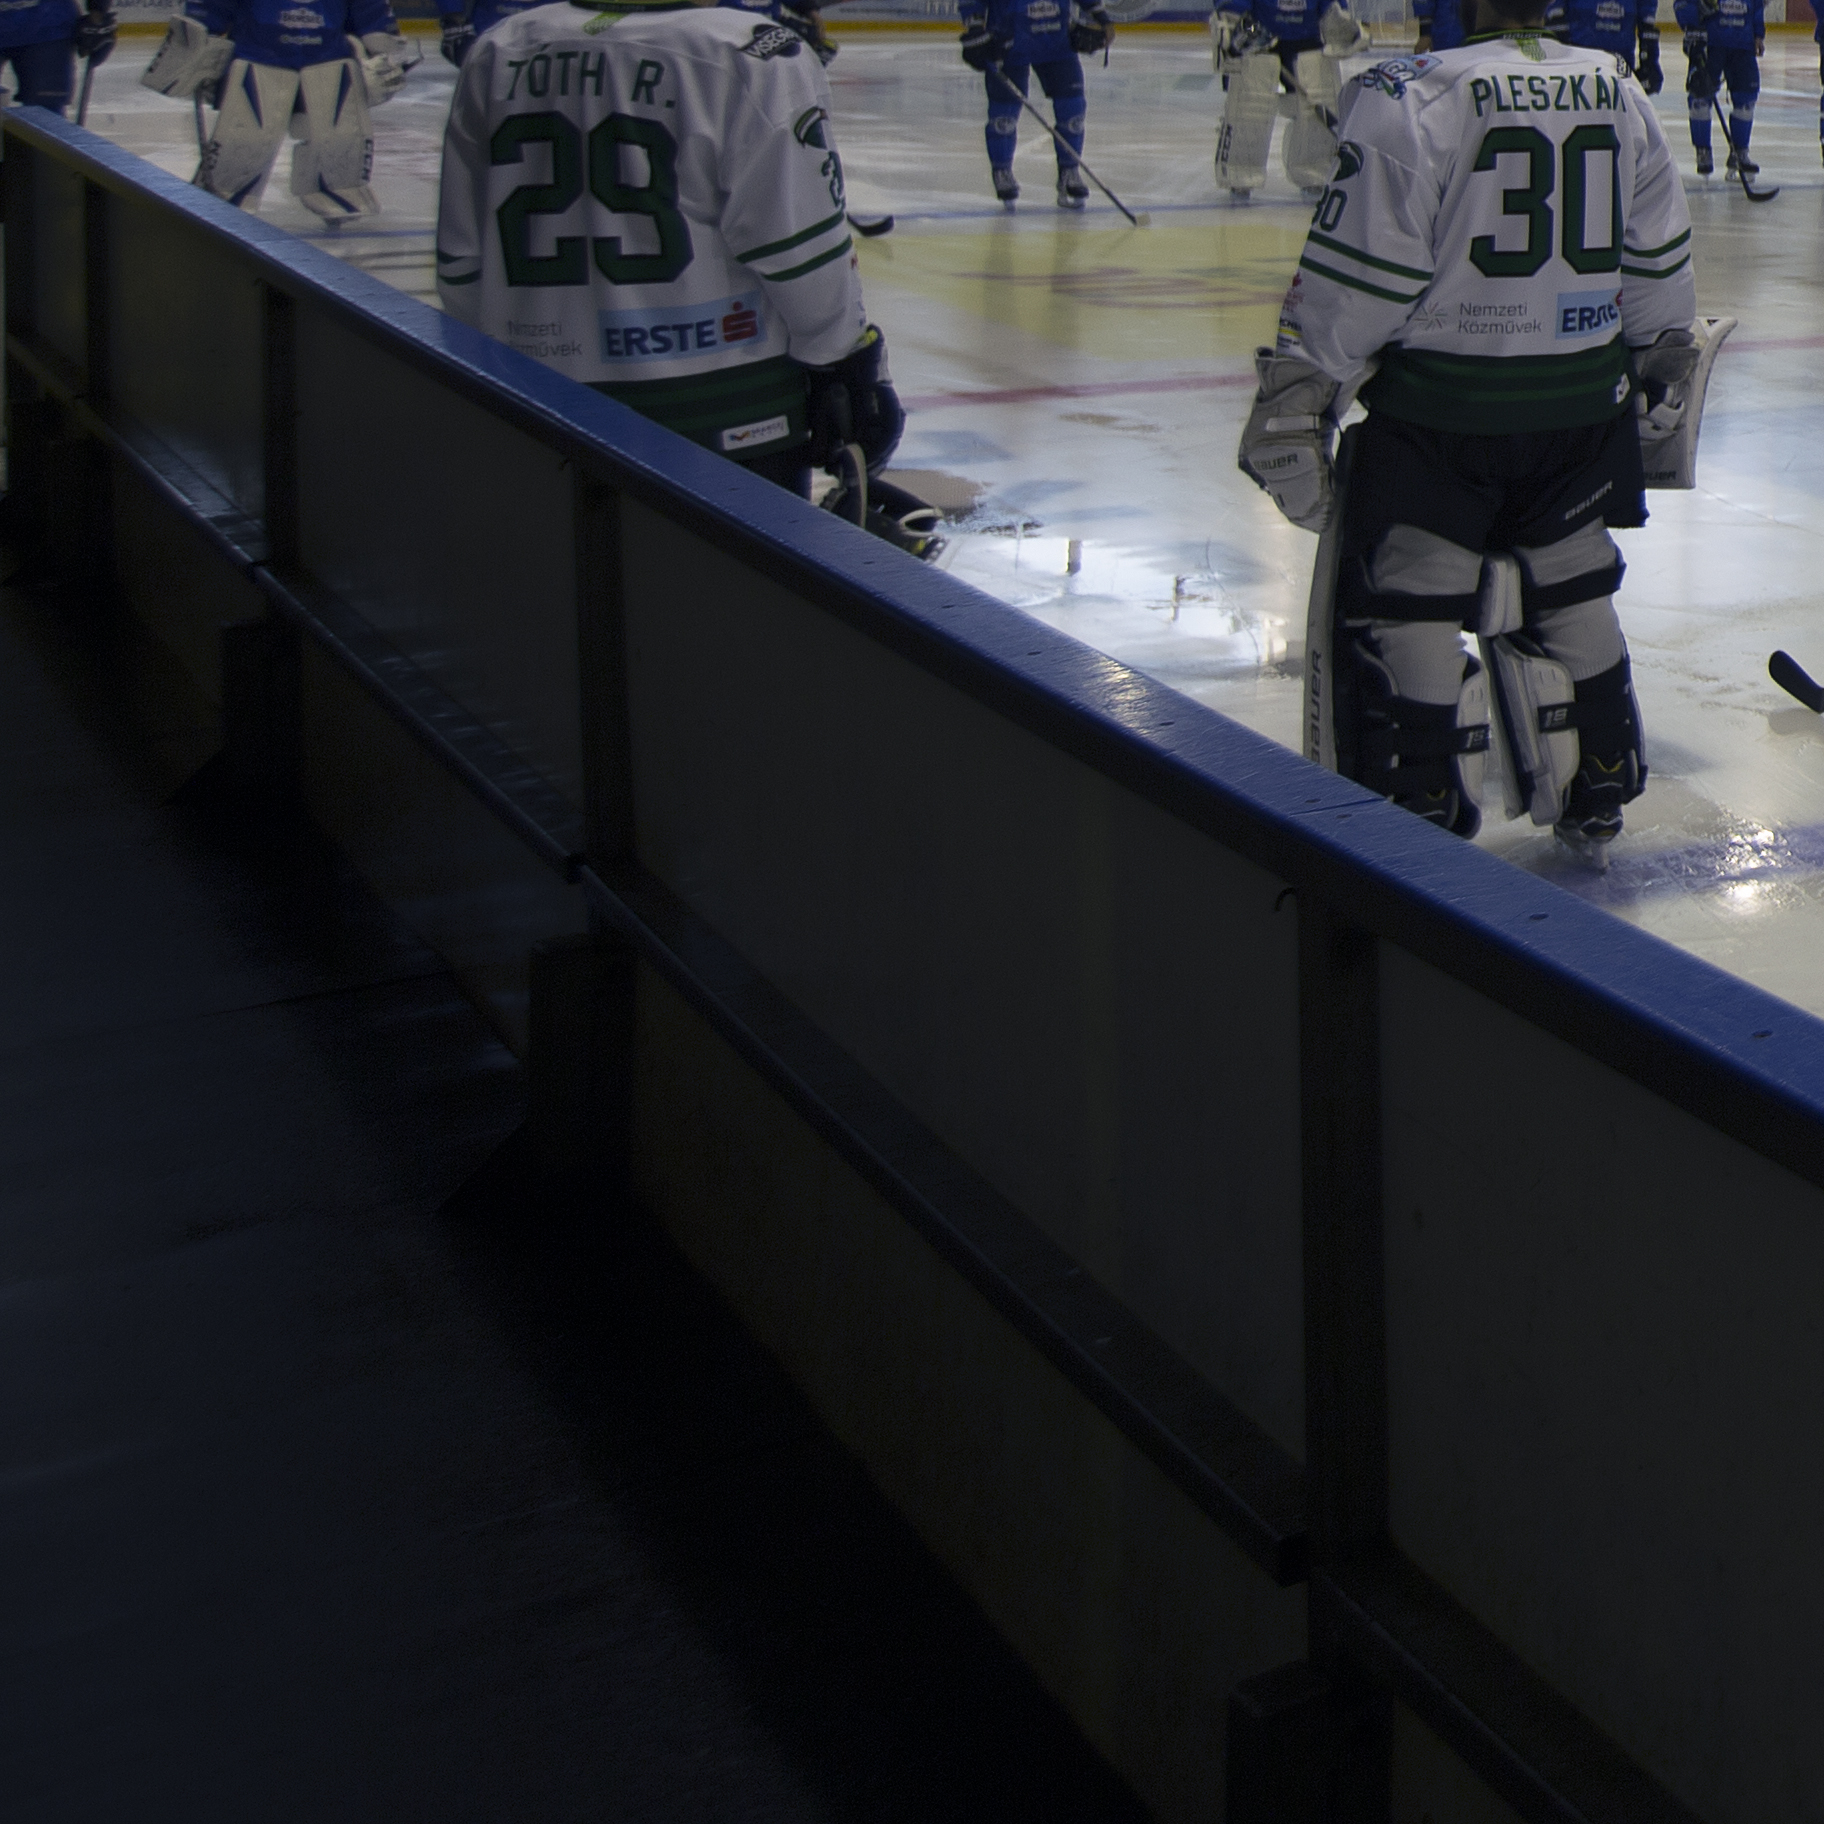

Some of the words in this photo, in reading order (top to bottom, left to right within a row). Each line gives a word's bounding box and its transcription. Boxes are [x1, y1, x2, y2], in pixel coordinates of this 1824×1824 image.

[507, 44, 605, 102] TÓTH
[631, 59, 675, 108] R.
[490, 110, 695, 287] 29
[1468, 124, 1625, 277] 30
[1457, 318, 1542, 336] Közművek
[1459, 301, 1528, 317] Nemzeti
[605, 318, 718, 358] ERSTE
